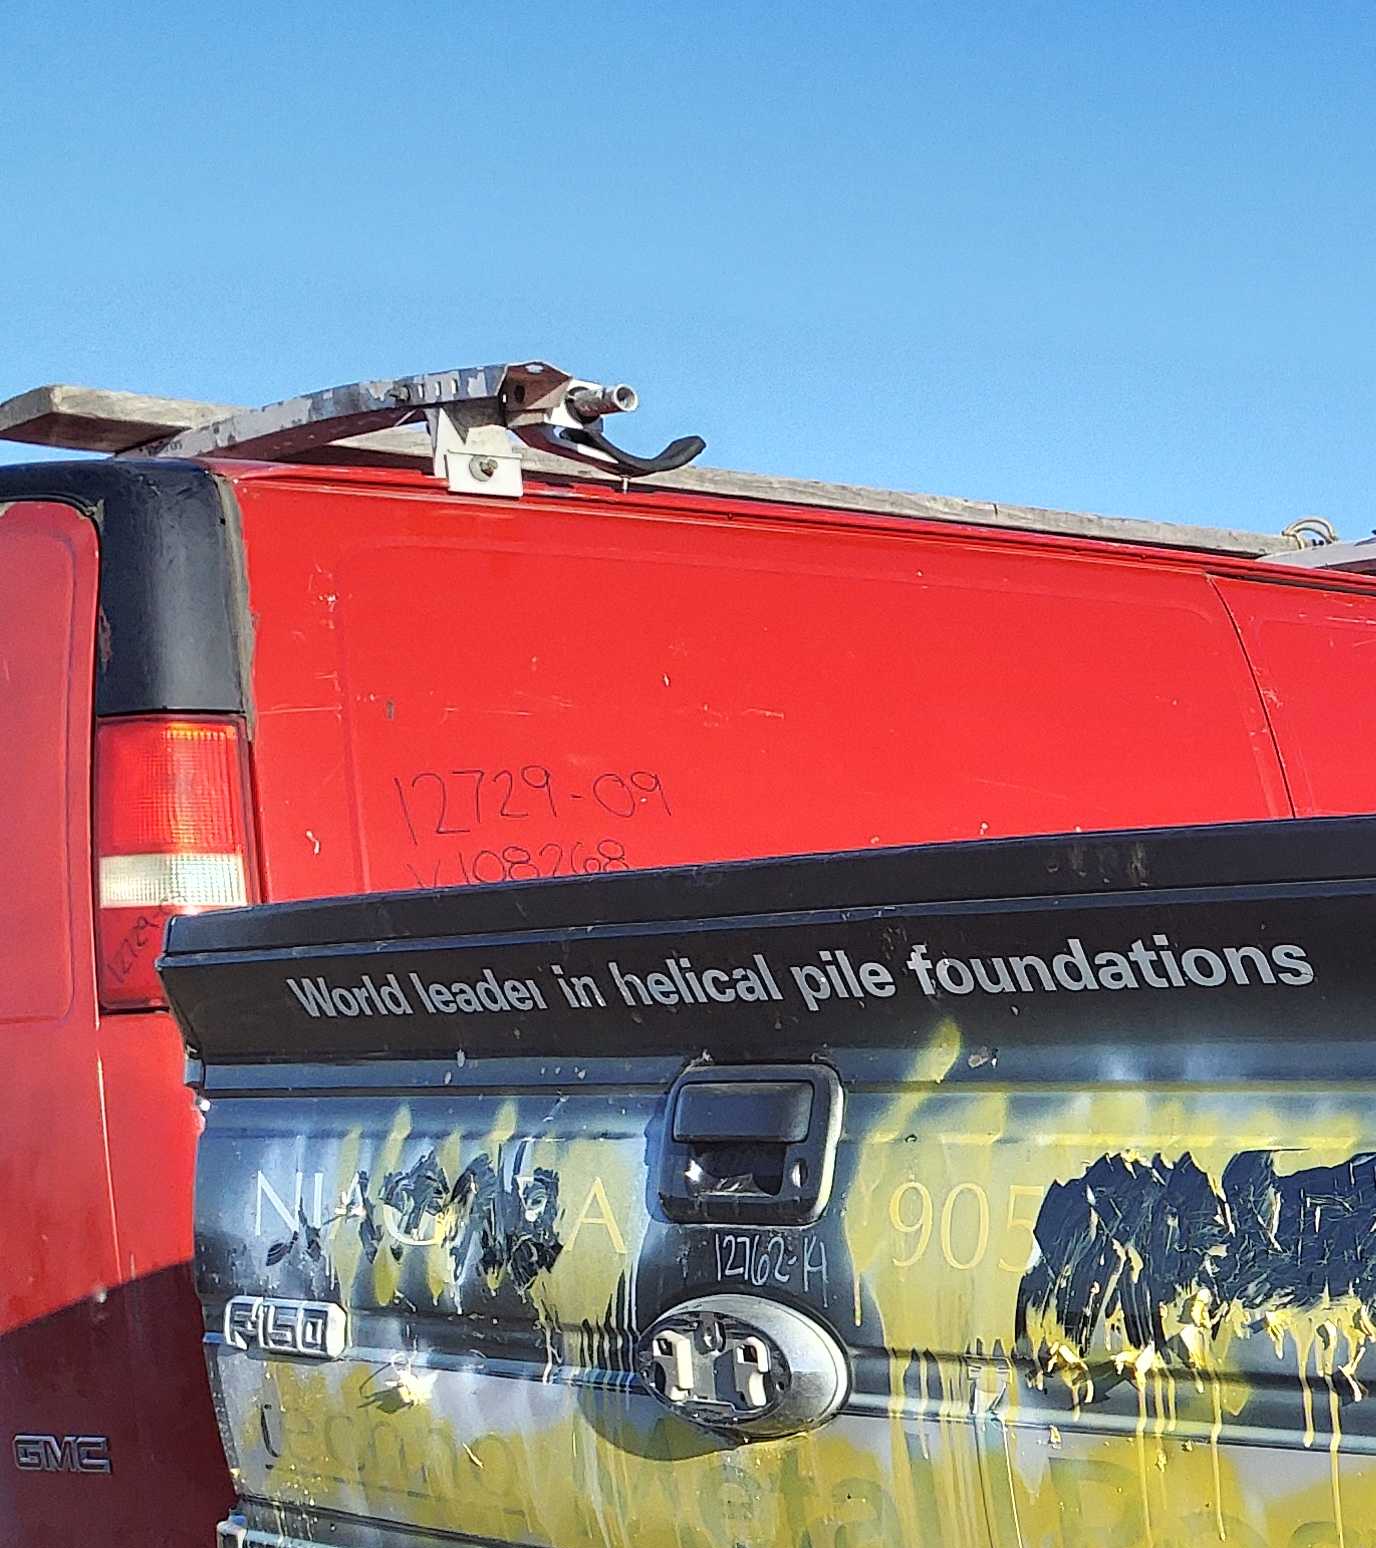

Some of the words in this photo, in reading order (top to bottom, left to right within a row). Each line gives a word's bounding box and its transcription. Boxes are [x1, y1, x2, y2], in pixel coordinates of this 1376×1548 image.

[394, 765, 672, 846] 12729-09
[286, 973, 414, 1018] World
[409, 969, 548, 1014] leader
[550, 963, 606, 1008] in
[608, 954, 784, 1006] helical
[789, 949, 897, 1012] pile
[907, 934, 1314, 996] foundations
[256, 1170, 629, 1254] NIAGA
[13, 1434, 112, 1474] GMC
